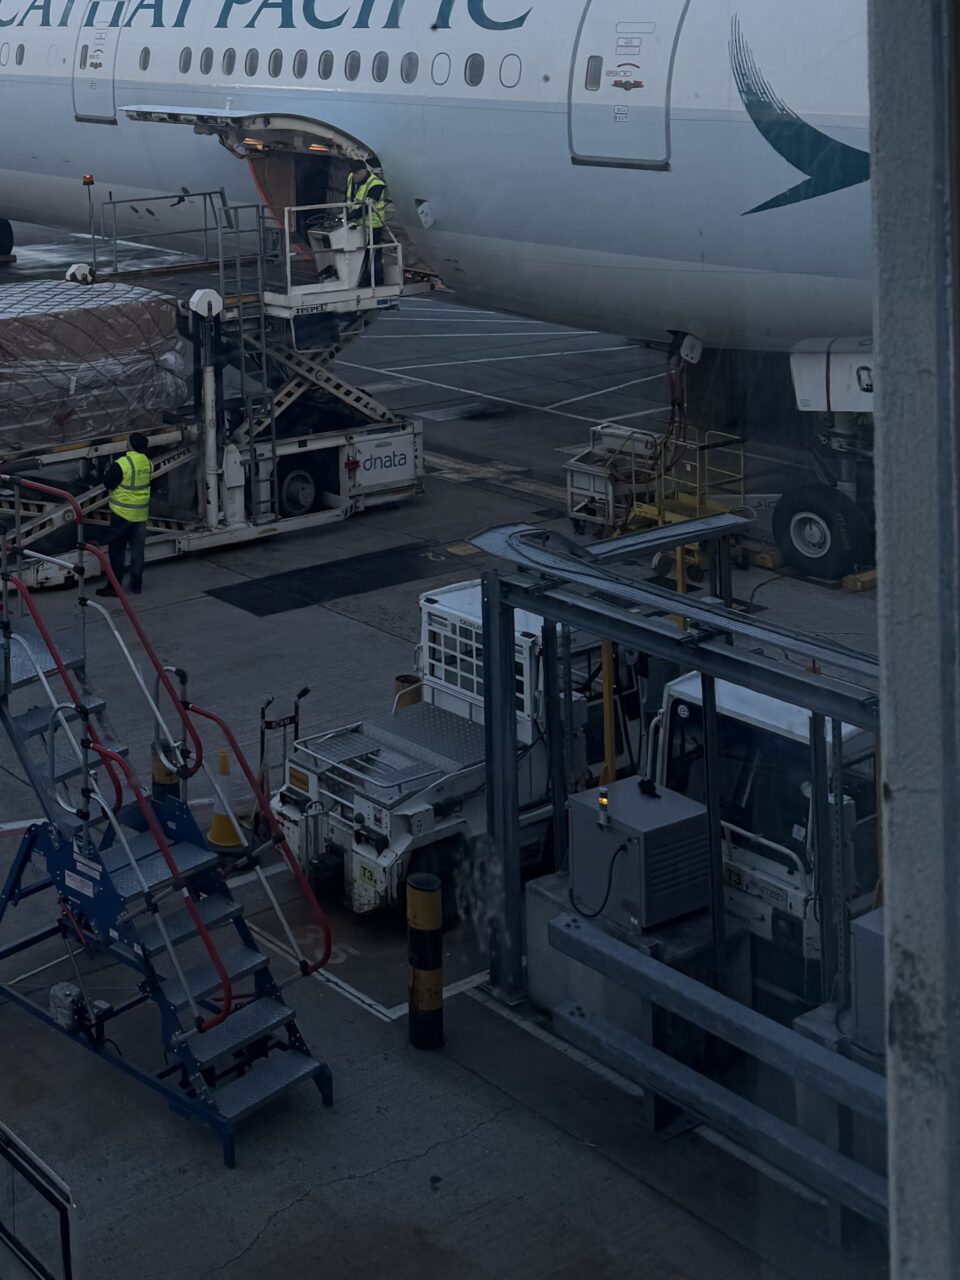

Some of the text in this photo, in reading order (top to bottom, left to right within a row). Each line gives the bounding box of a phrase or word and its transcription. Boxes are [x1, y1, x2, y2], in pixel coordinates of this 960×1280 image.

[363, 450, 407, 471] dnata
[361, 865, 374, 881] T3
[726, 868, 742, 886] T3
